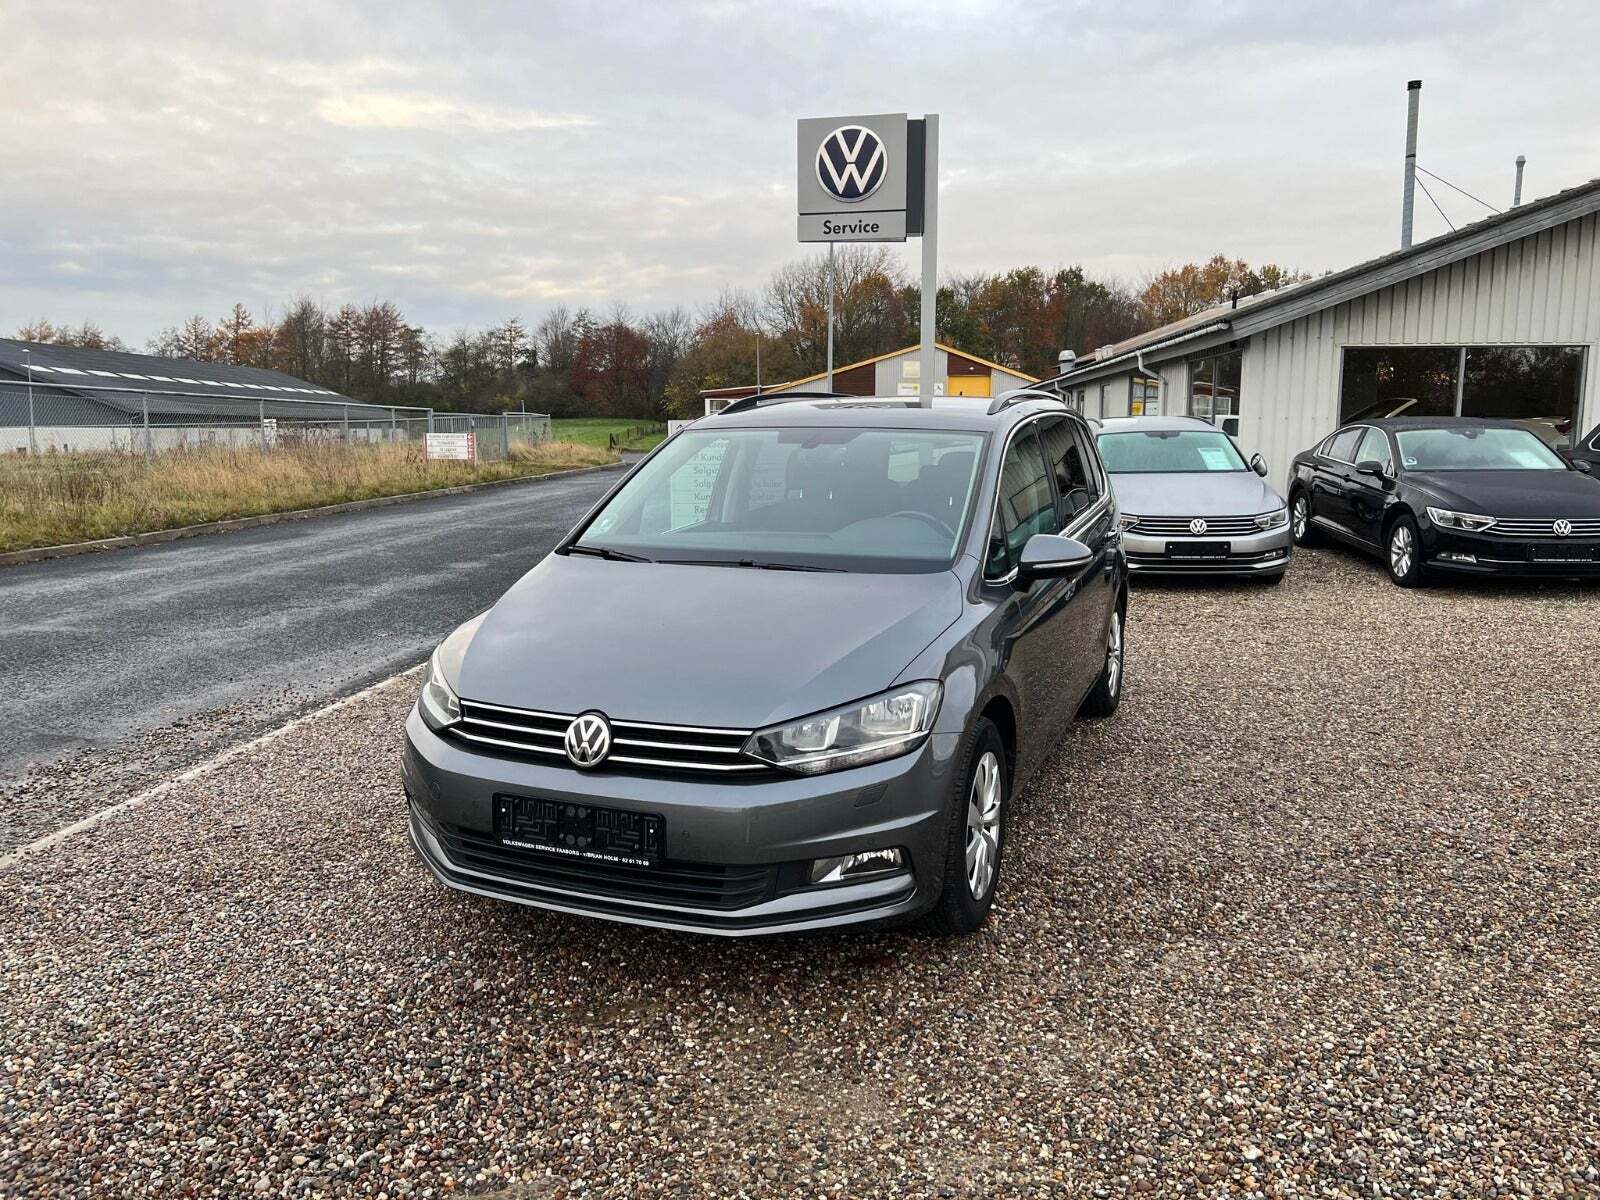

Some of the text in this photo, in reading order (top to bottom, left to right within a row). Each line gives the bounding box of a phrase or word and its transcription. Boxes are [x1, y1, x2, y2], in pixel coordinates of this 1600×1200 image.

[815, 125, 888, 203] VW
[823, 219, 880, 235] Service
[565, 714, 610, 767] VW
[502, 839, 535, 849] VOLKSWAGEN
[535, 844, 556, 852] SERVICE
[556, 847, 580, 856] FAABORG
